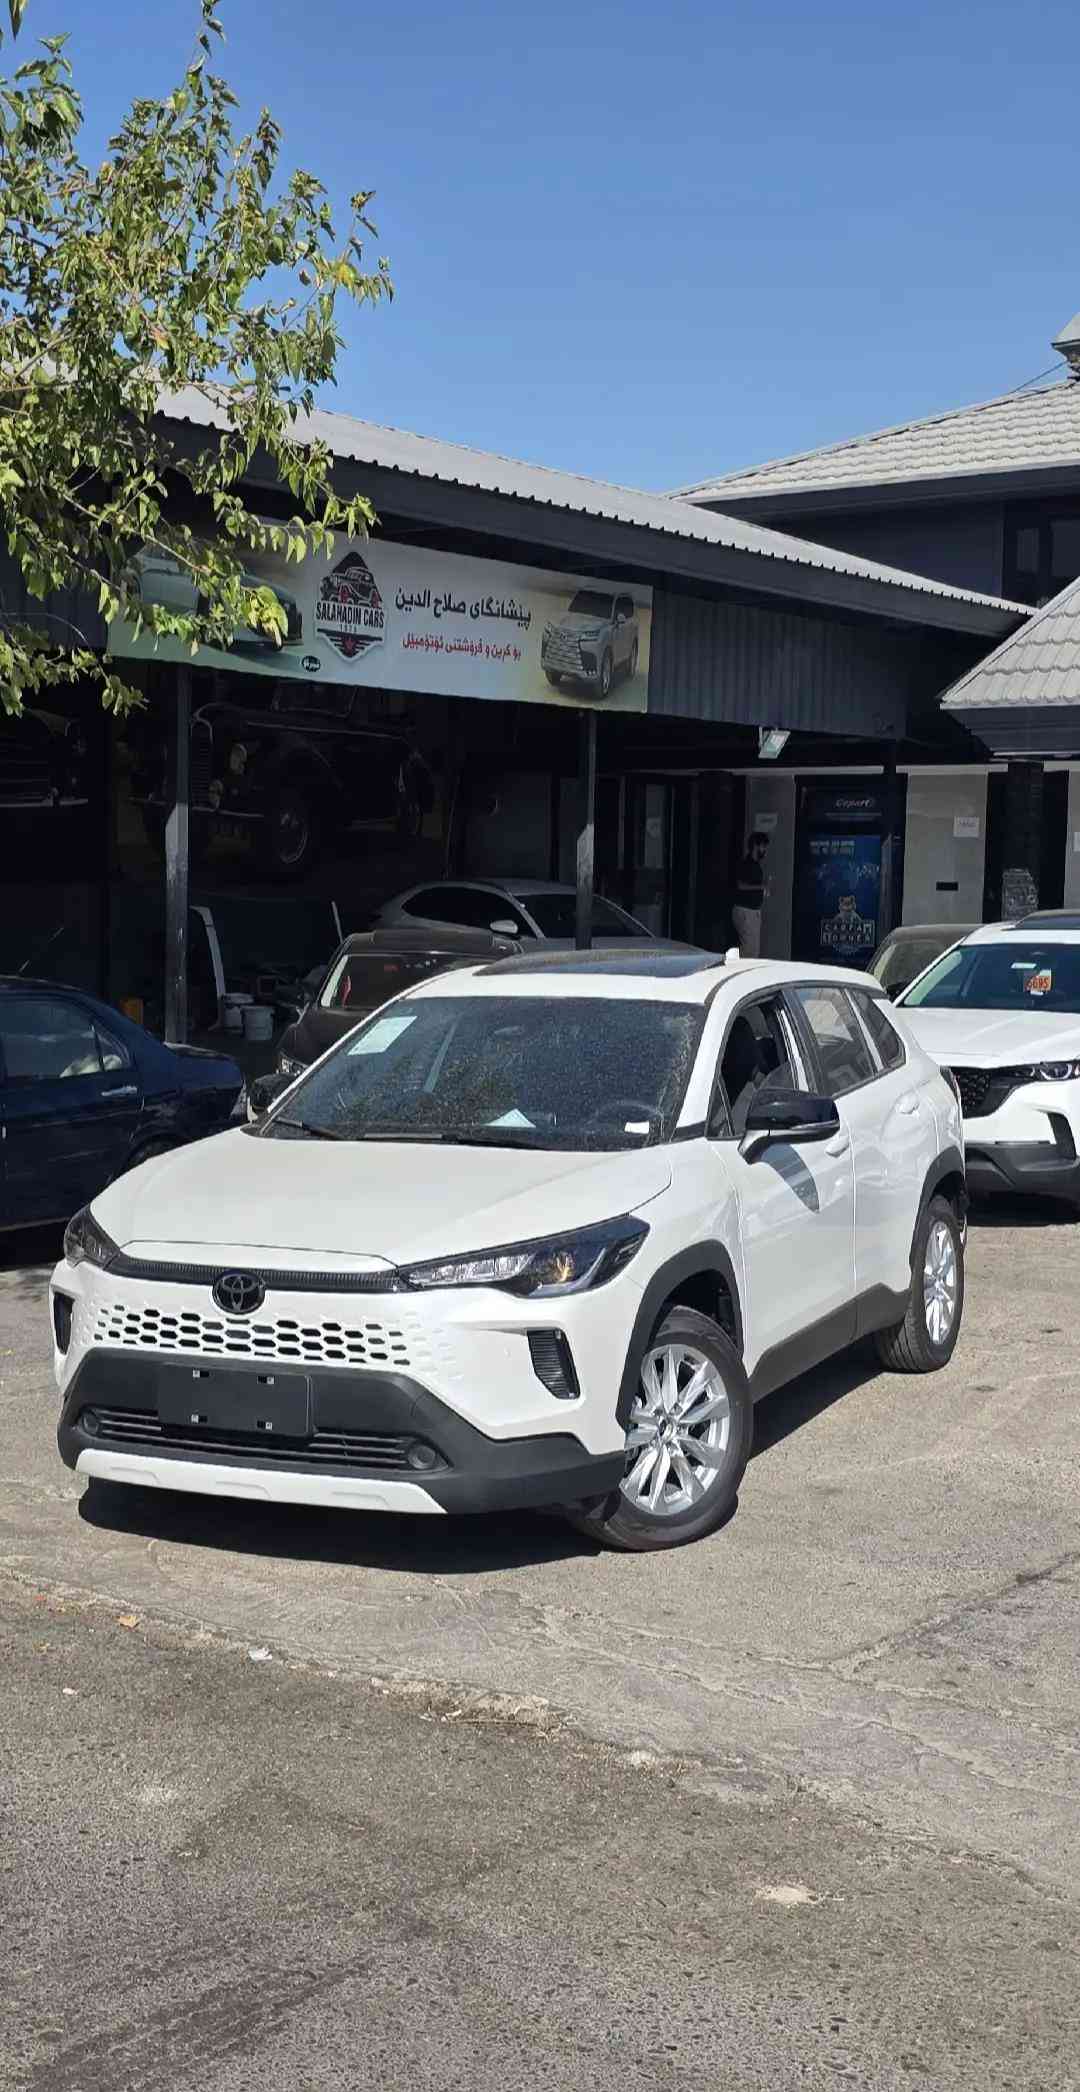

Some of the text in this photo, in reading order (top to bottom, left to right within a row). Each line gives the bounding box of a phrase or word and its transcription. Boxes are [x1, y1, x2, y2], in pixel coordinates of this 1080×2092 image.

[316, 602, 385, 628] SALAHADIN CARS
[433, 592, 466, 618] صلاح
